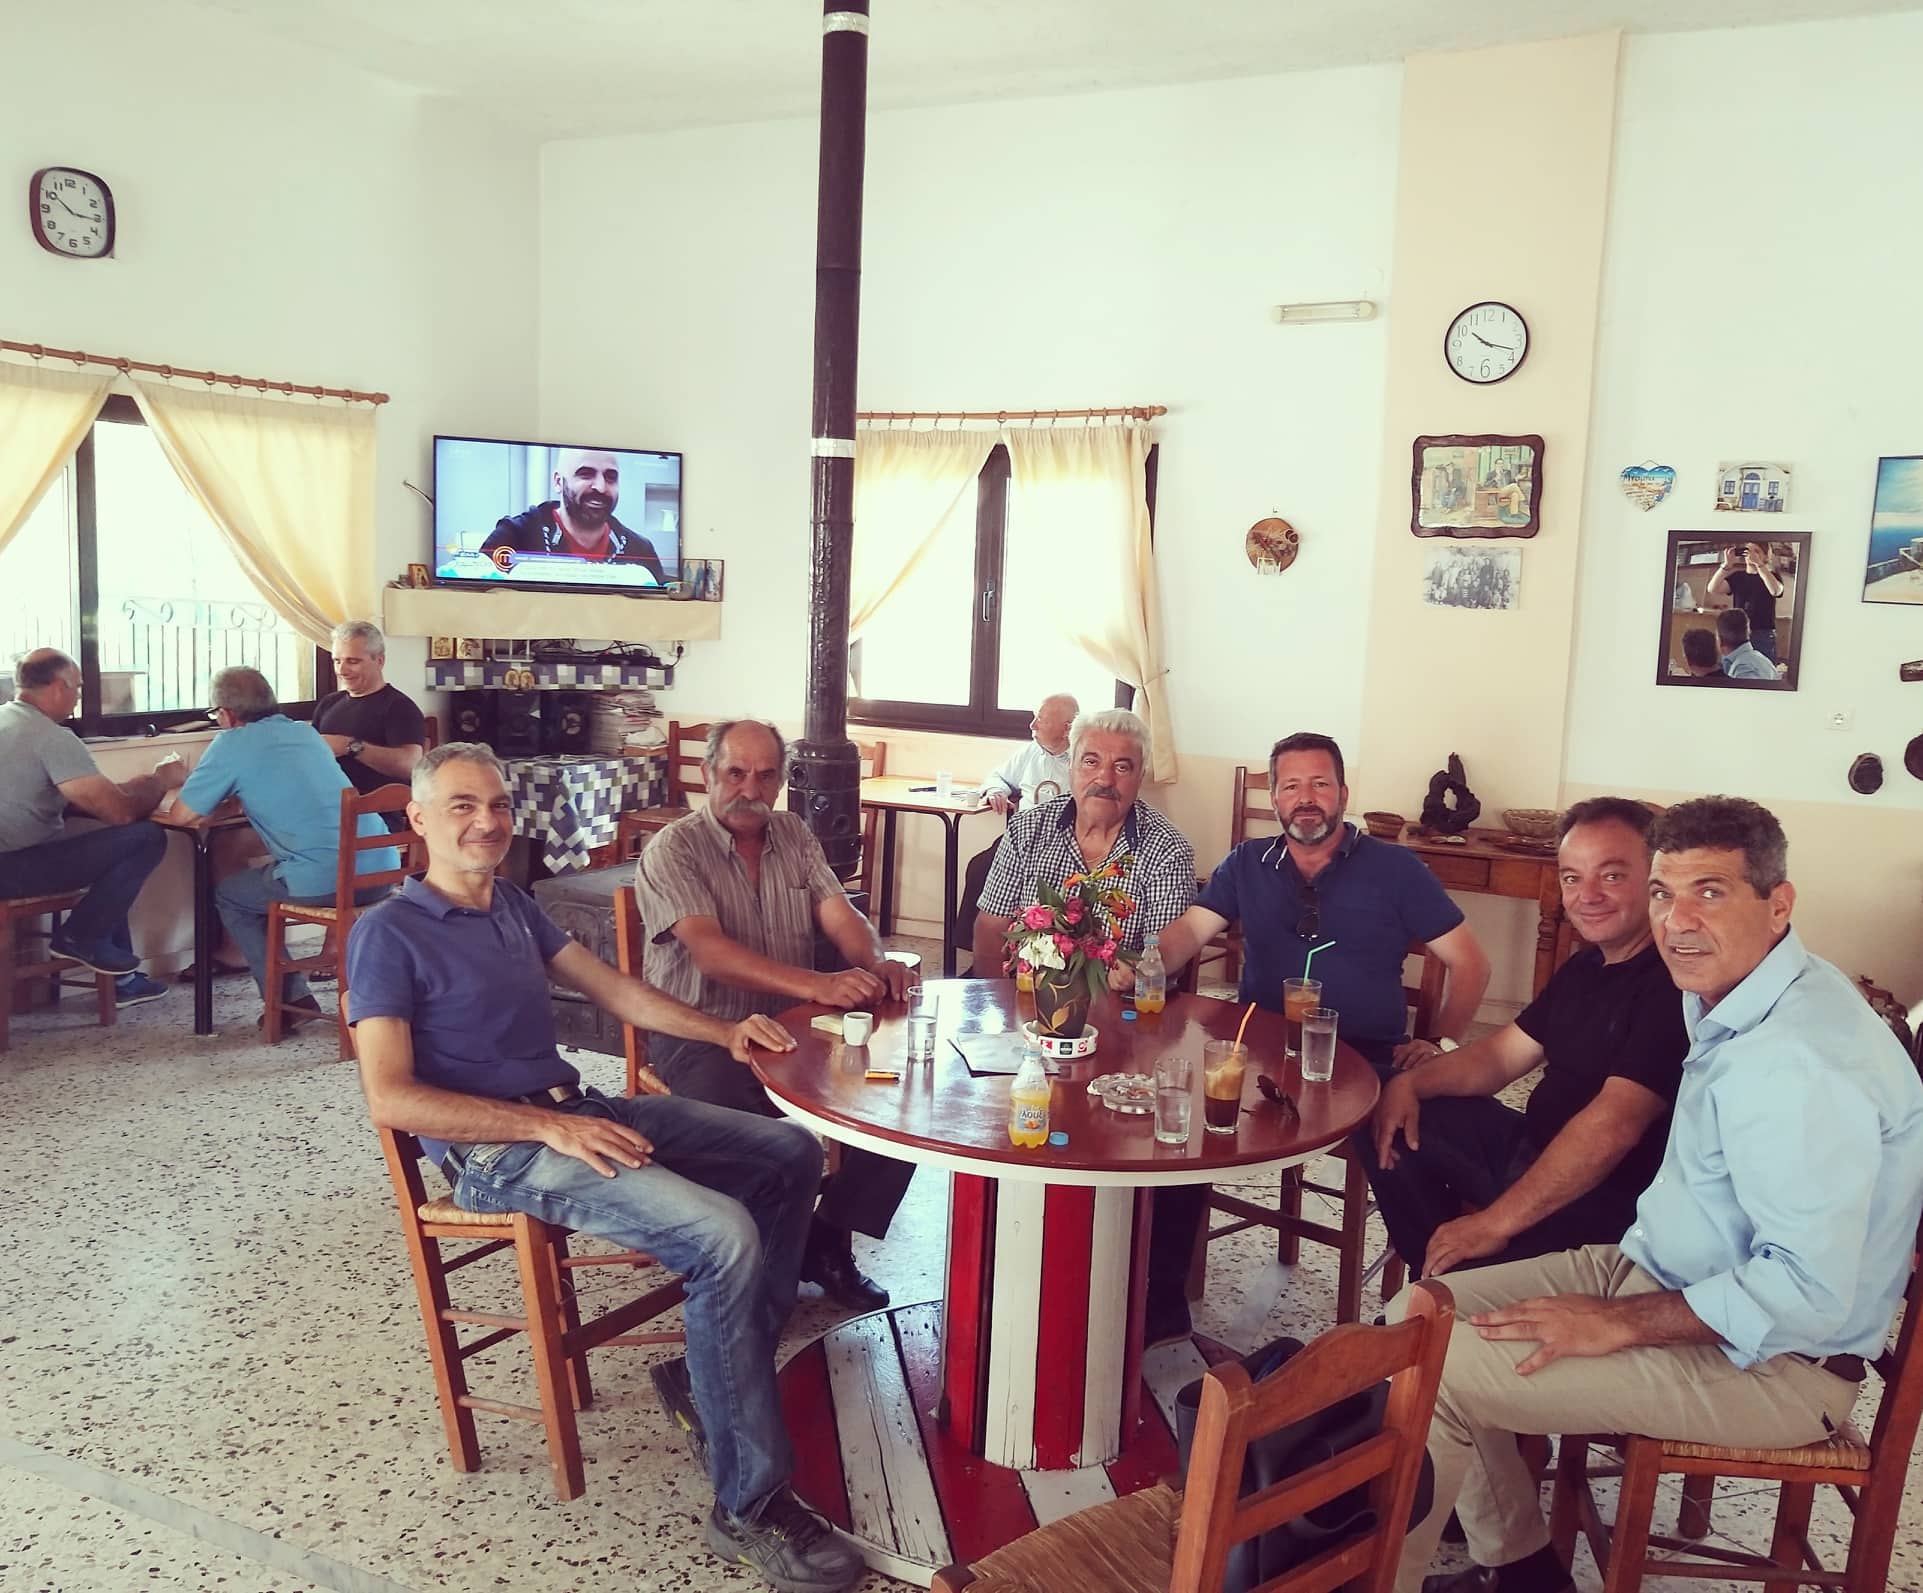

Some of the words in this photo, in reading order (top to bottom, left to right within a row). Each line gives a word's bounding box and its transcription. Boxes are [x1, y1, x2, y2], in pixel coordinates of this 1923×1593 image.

[54, 181, 63, 192] 11
[64, 178, 76, 189] 12
[45, 189, 57, 201] 10
[41, 203, 51, 214] 9
[89, 198, 98, 209] 2
[47, 220, 57, 230] 8
[57, 231, 65, 241] 7
[90, 226, 98, 236] 4
[68, 238, 78, 248] 6
[82, 236, 91, 246] 5
[1470, 312, 1479, 326] 11
[1482, 308, 1496, 323] 12
[1457, 324, 1468, 339] 10
[1456, 355, 1463, 367] 8
[1507, 351, 1515, 364] 4
[1480, 358, 1491, 379] 6
